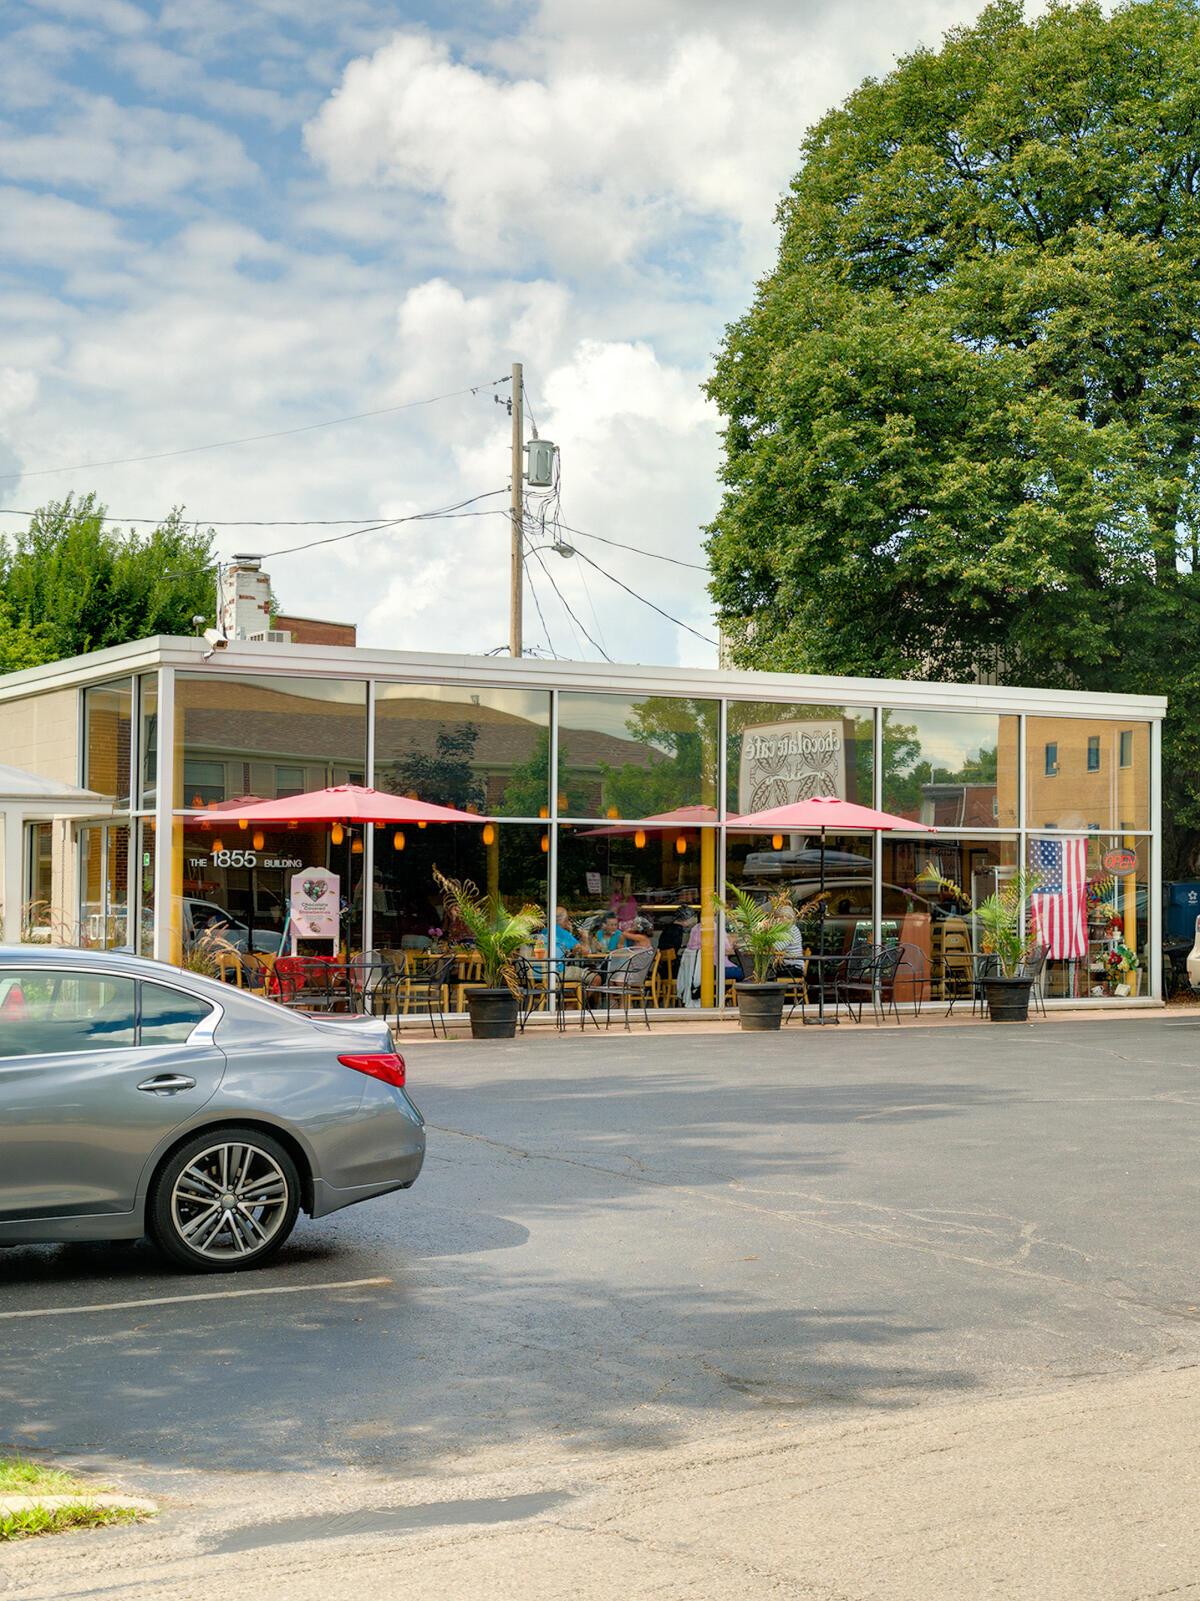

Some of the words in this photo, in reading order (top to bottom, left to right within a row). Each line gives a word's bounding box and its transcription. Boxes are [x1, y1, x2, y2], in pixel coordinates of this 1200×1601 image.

[190, 859, 207, 867] THE
[209, 850, 256, 868] 1855
[264, 859, 302, 868] BUILDING
[1104, 854, 1137, 869] OPEN
